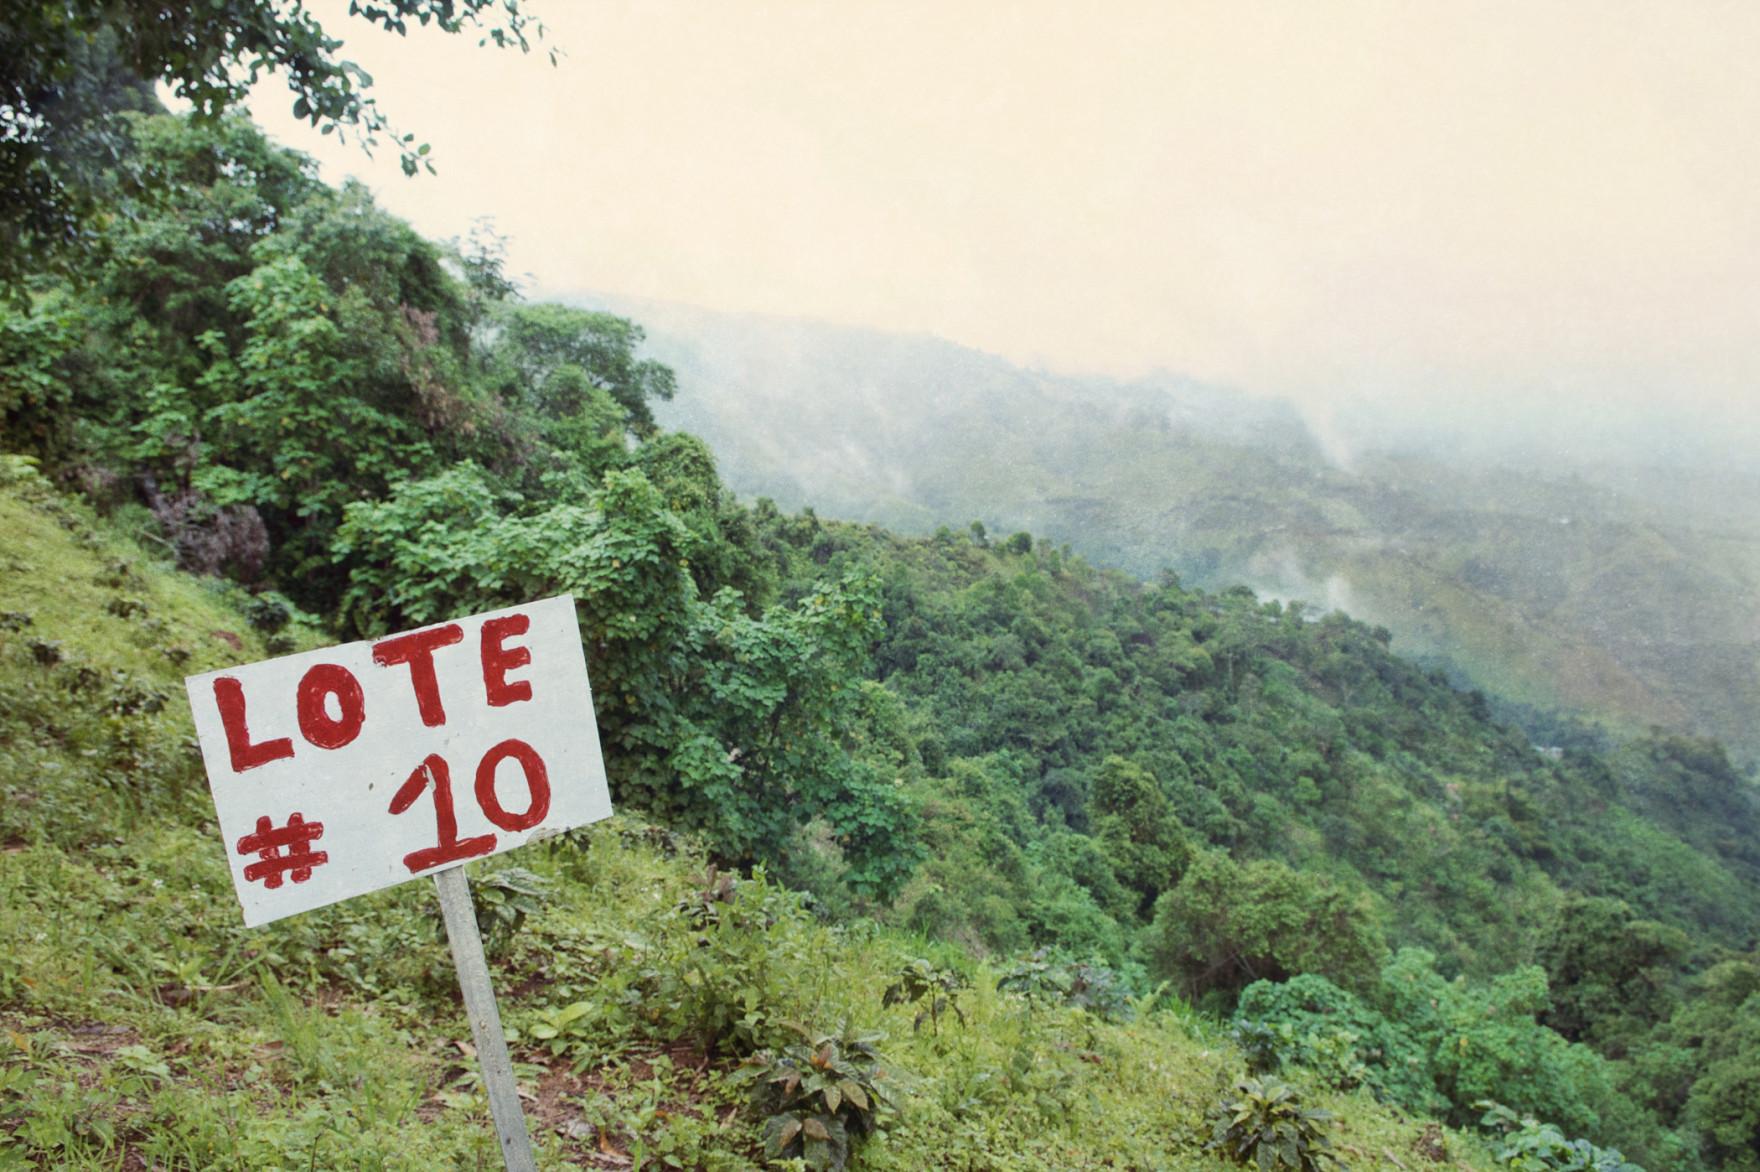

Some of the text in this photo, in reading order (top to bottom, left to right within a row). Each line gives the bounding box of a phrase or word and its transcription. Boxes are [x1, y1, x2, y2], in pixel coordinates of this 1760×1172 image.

[213, 613, 533, 774] LOTE
[236, 738, 551, 889] # 10
